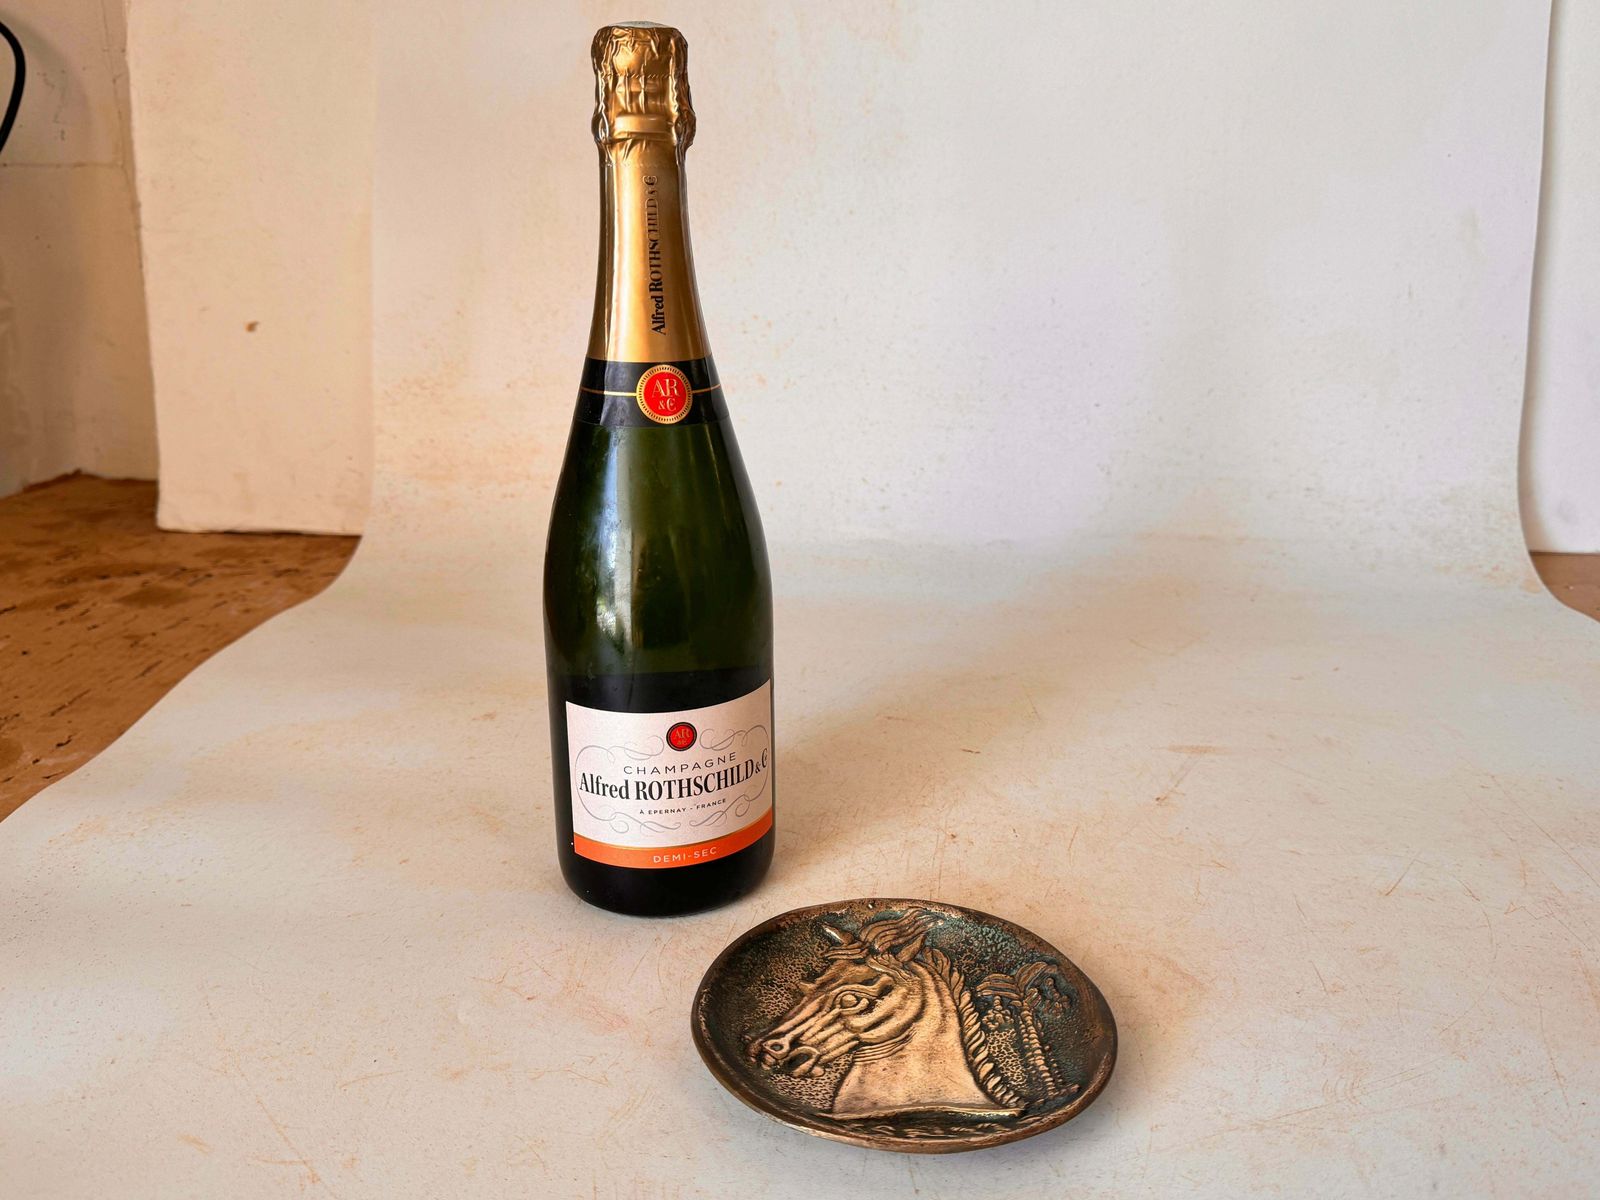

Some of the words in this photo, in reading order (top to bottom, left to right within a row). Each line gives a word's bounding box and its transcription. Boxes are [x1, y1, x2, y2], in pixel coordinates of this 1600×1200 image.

[645, 198, 664, 292] ROTHSCHILD
[651, 296, 667, 336] Alfred
[652, 378, 680, 398] AR
[623, 752, 737, 775] CHAMPAGNE
[579, 772, 630, 800] Alfred
[696, 798, 727, 810] FRANCE
[653, 846, 718, 864] DEMI-SEC
